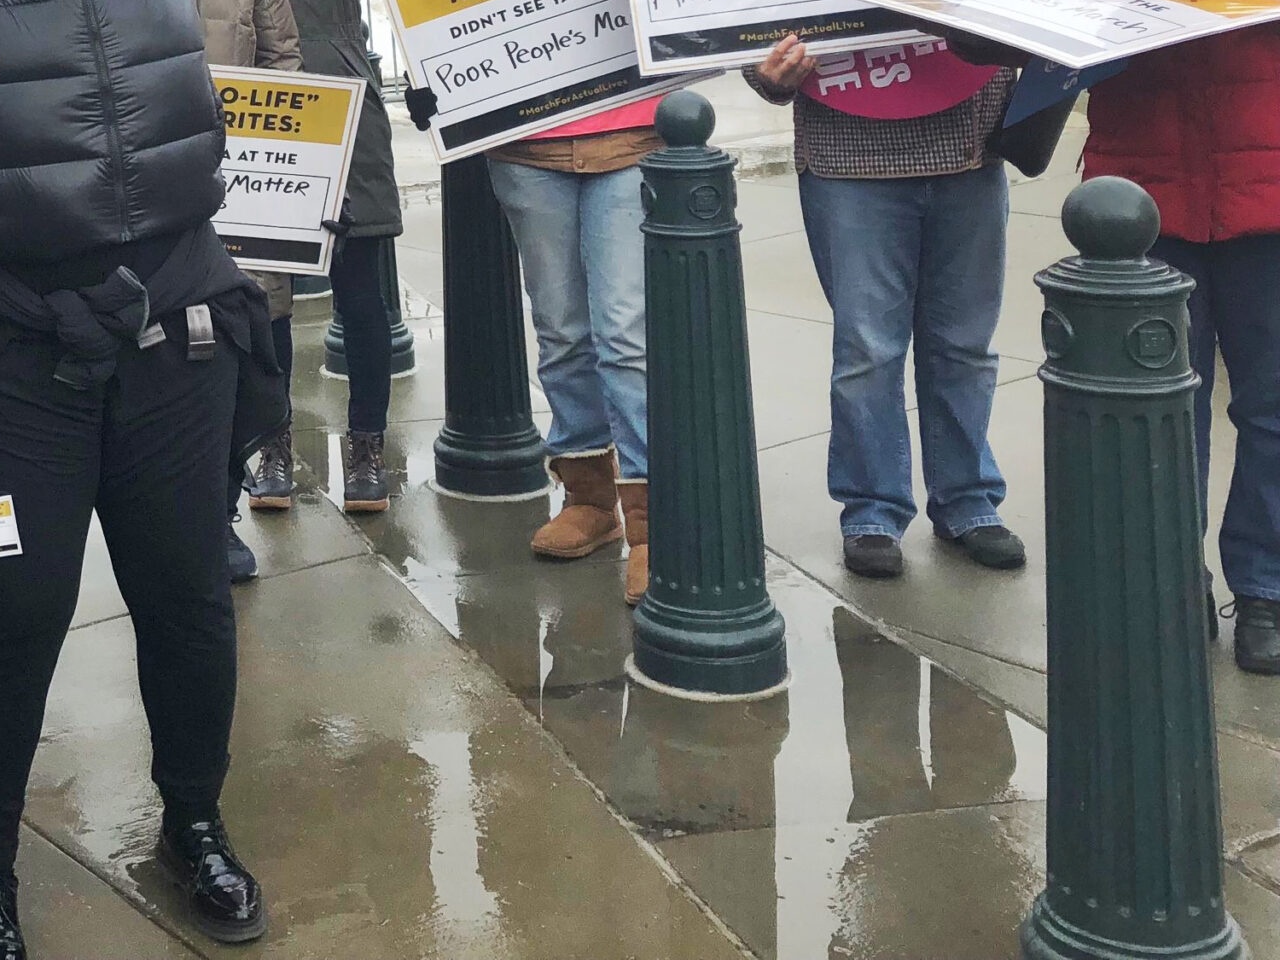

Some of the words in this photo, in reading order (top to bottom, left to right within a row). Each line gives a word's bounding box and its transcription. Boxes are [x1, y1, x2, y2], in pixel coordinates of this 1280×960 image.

[1133, 0, 1170, 13] THE
[449, 9, 508, 39] DIDN'T
[739, 19, 865, 43] #MarchForActualLives
[435, 58, 500, 94] POOR
[504, 29, 587, 70] People's
[220, 86, 320, 110] O-LIFE”
[519, 78, 629, 117] #MarchForActualLives
[224, 110, 302, 133] RITES:
[238, 150, 258, 162] AT
[265, 152, 298, 165] THE
